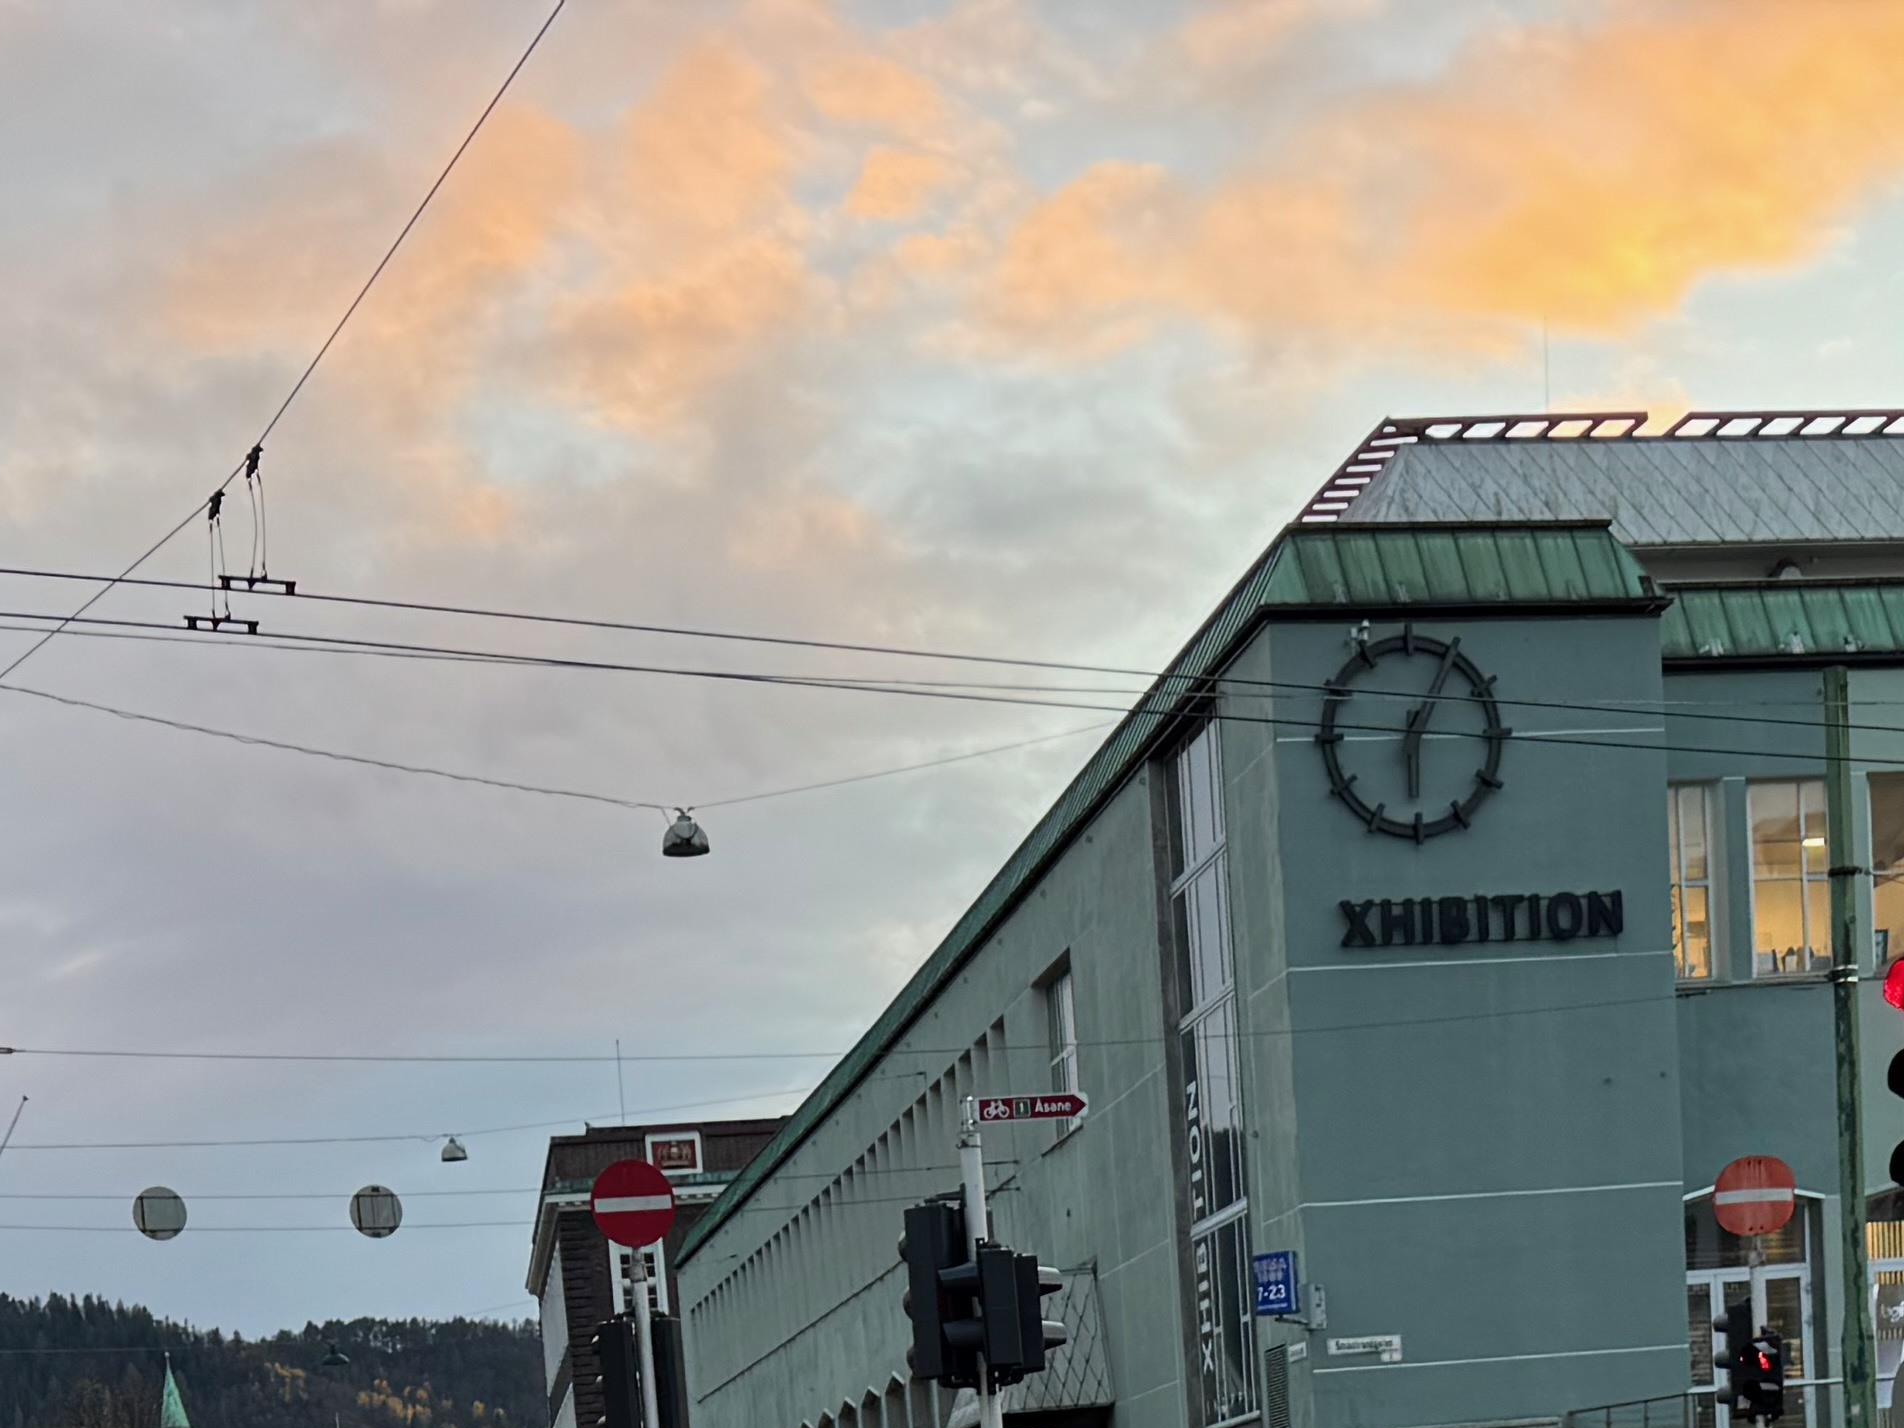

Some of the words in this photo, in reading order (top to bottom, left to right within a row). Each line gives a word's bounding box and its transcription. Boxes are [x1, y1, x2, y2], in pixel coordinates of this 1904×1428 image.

[1337, 888, 1624, 947] XHIBITION
[1034, 1097, 1072, 1113] Åsane
[1186, 1080, 1215, 1375] XHIBTION
